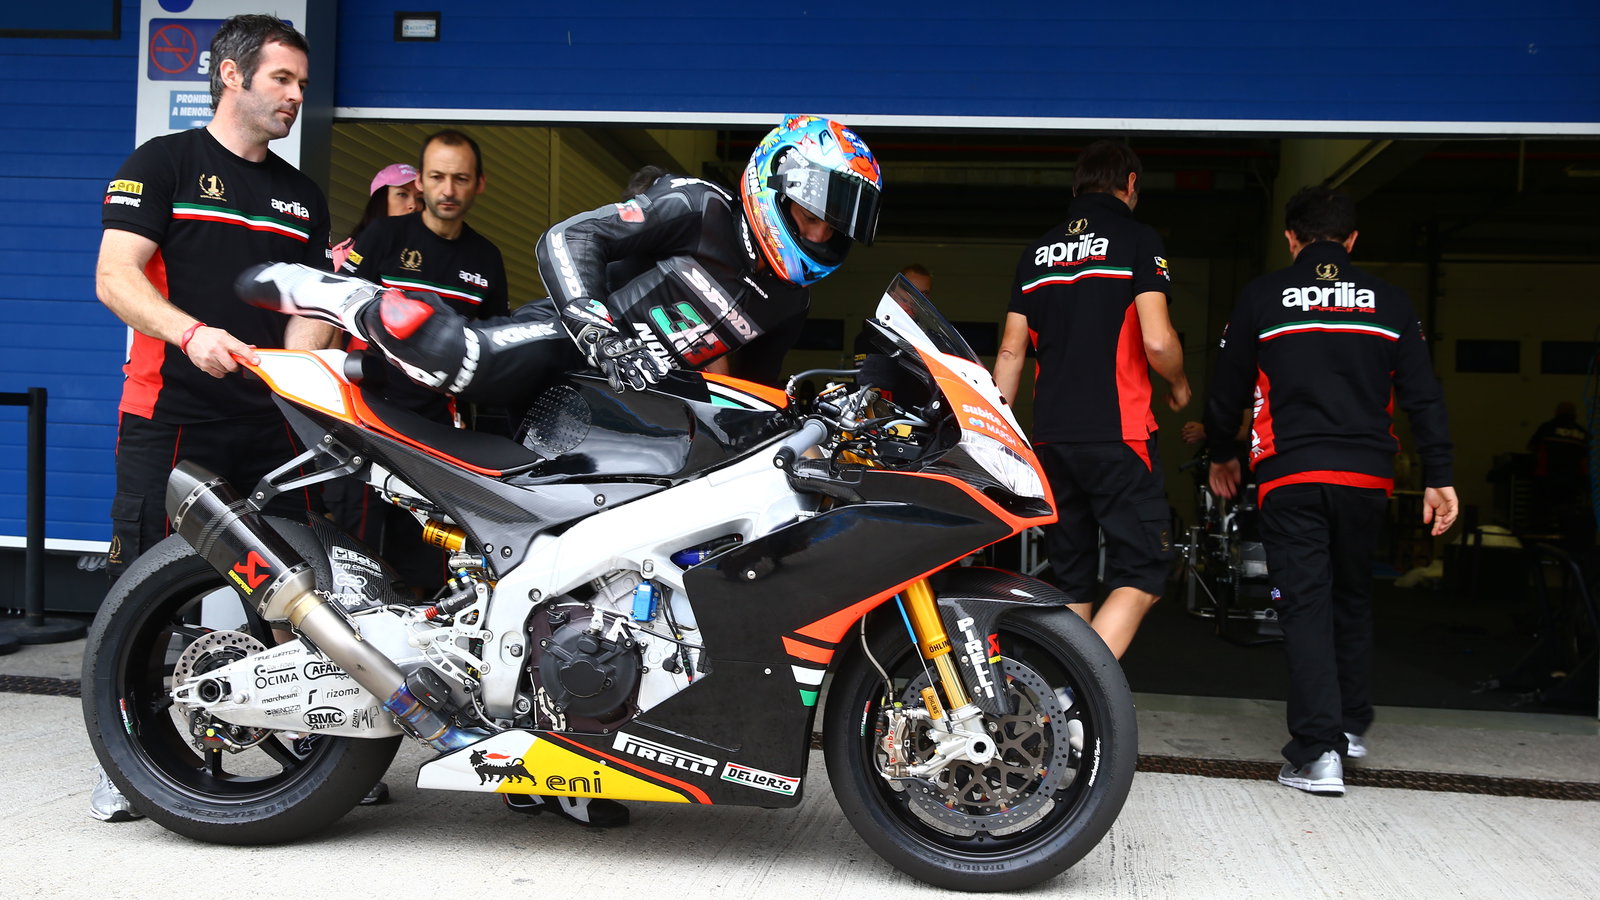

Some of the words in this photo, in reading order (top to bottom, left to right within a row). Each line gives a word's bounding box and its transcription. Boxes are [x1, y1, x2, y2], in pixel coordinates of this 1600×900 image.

[171, 107, 178, 116] A
[118, 182, 141, 194] eni
[271, 198, 310, 219] aprilia
[1034, 233, 1109, 267] aprilia
[459, 270, 488, 288] aprilia
[1282, 282, 1375, 311] aprilia
[986, 422, 1017, 446] MARSH
[956, 617, 996, 698] PIRELLI
[262, 692, 298, 704] marchesini
[326, 687, 360, 699] rizoma
[308, 712, 343, 724] BMC
[311, 723, 326, 731] Air
[612, 731, 718, 777] PIRELLI
[546, 771, 602, 794] eni
[953, 862, 1005, 872] DIABLO
